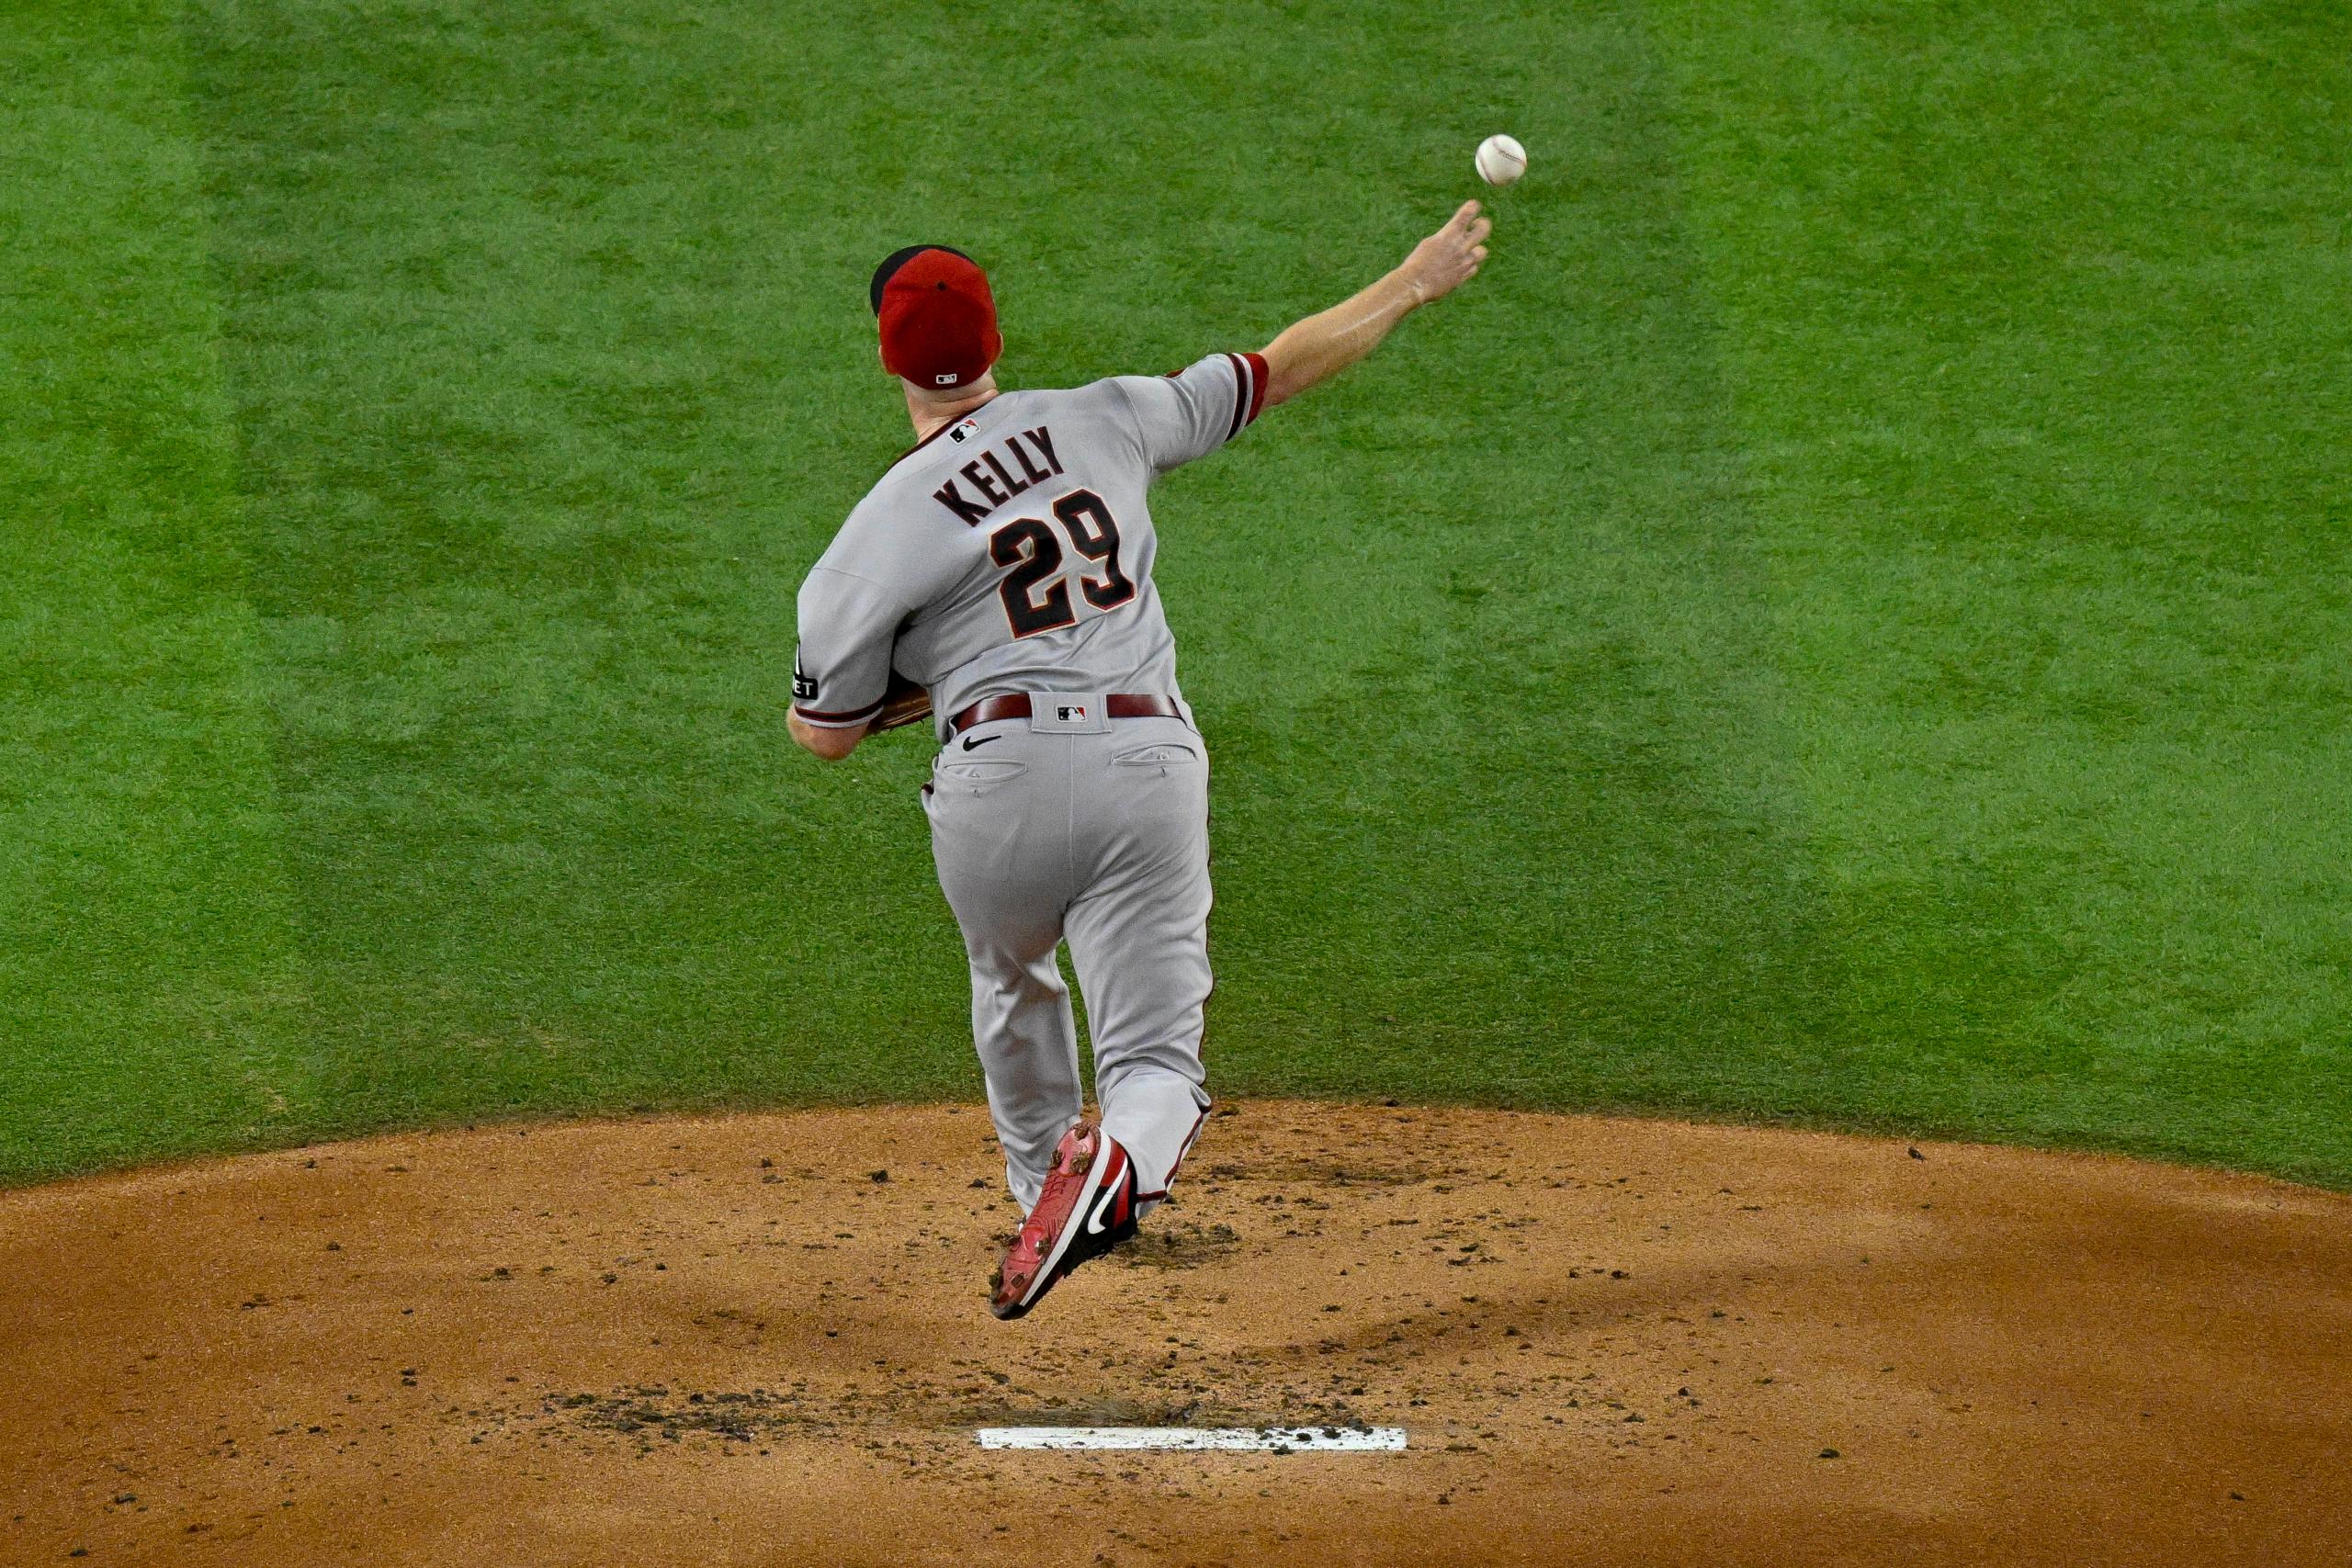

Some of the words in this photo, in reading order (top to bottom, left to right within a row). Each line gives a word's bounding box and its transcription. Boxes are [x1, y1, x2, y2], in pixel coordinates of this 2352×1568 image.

[933, 426, 1064, 527] KELLY
[989, 488, 1136, 639] 29
[792, 676, 813, 695] ET
